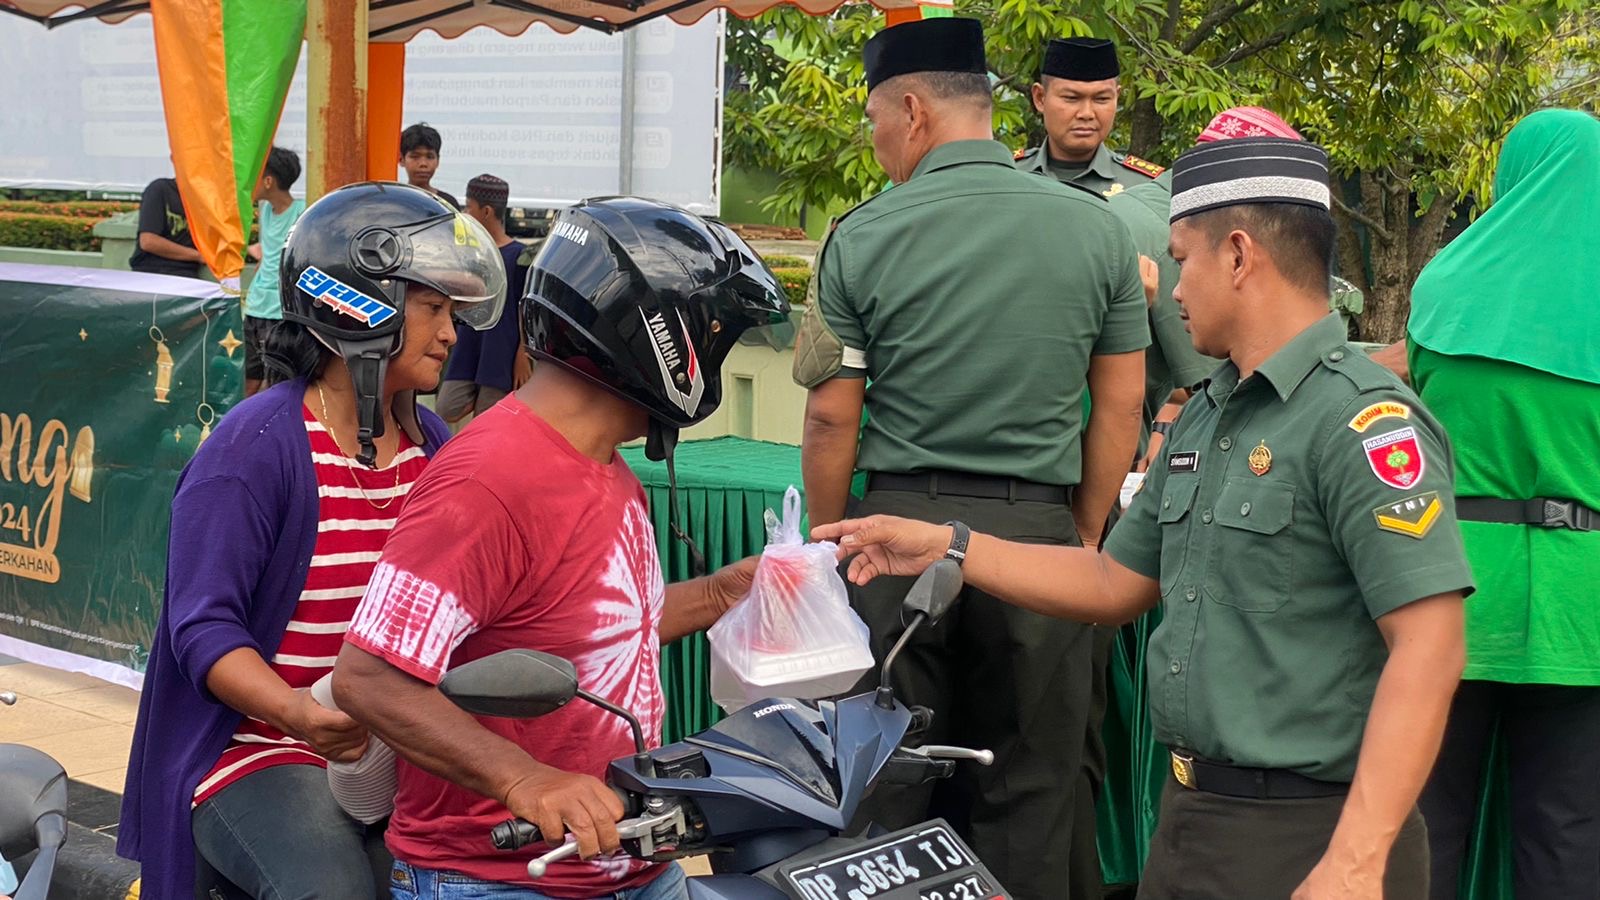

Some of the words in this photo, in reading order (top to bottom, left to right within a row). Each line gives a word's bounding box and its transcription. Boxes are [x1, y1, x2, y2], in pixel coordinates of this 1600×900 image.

[649, 313, 682, 370] YAMAHA
[1355, 406, 1383, 428] KODIM
[1366, 429, 1413, 449] HASANUDDIN
[1391, 497, 1426, 515] TNI
[0, 550, 53, 575] ERKAHAN
[753, 703, 796, 718] HONDA
[799, 873, 839, 900] DP
